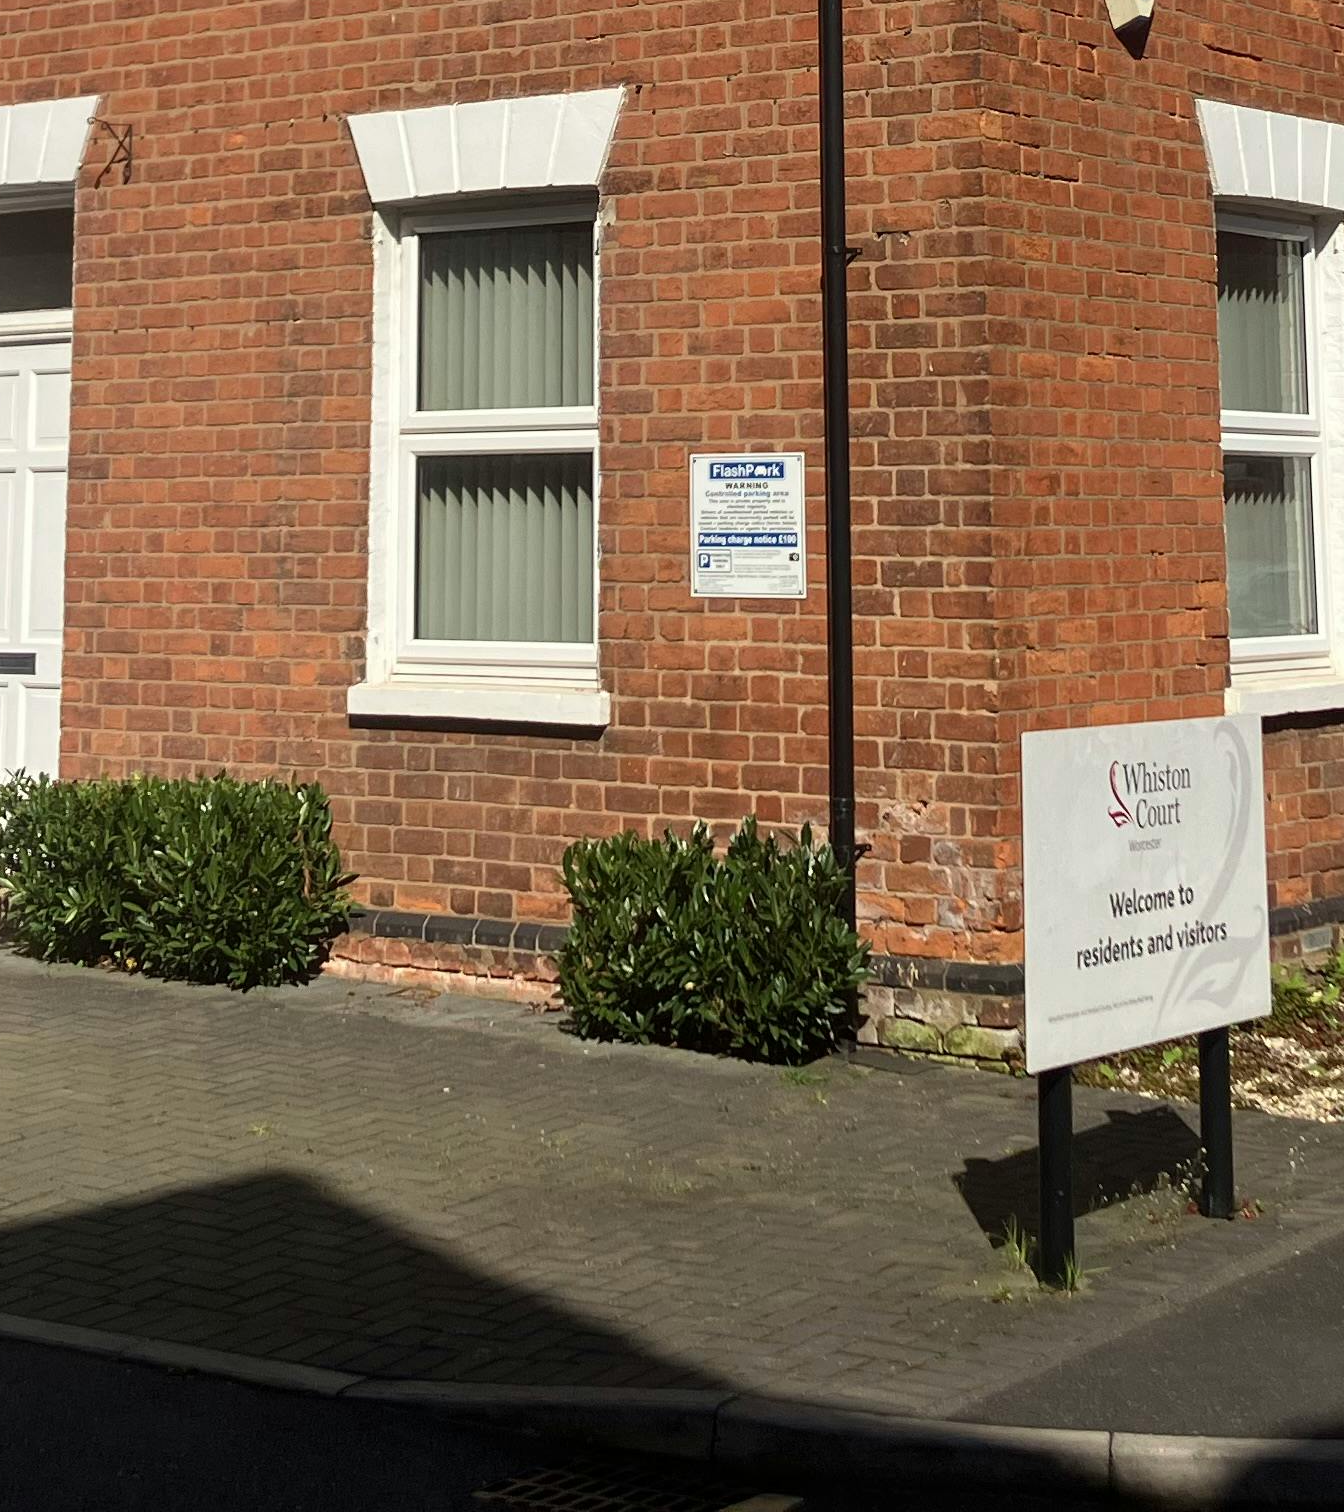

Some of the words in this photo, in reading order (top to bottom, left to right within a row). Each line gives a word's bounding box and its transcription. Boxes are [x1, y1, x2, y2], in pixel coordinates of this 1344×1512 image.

[725, 481, 769, 489] WARNING
[743, 490, 770, 498] parking
[699, 534, 727, 546] Parking
[727, 535, 753, 546] charge
[753, 534, 777, 544] notice
[1122, 761, 1192, 795] Whiston
[1136, 797, 1182, 829] Court
[1109, 887, 1175, 918] Welcome
[1178, 883, 1194, 906] to
[1076, 935, 1144, 970] residents
[1147, 923, 1174, 955] and
[1176, 919, 1228, 949] visitors
